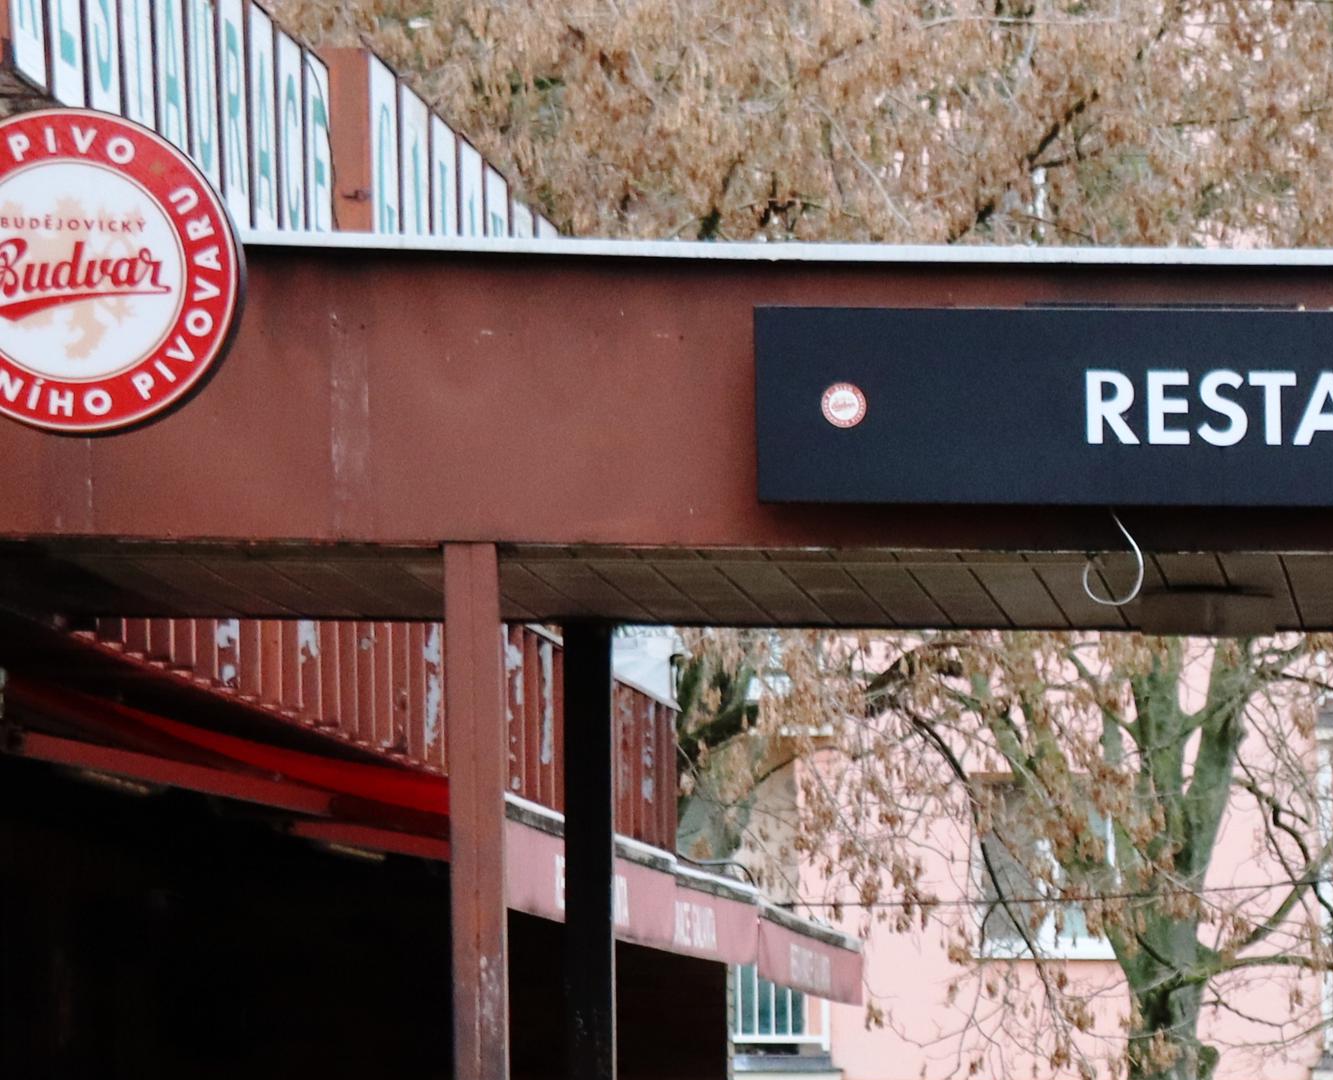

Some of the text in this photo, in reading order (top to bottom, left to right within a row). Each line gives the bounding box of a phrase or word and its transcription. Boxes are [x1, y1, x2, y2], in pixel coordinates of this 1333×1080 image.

[8, 126, 136, 165] PIVO
[1, 214, 147, 232] BUDĚJOVICKÝ
[131, 184, 222, 400] PIVOVARU
